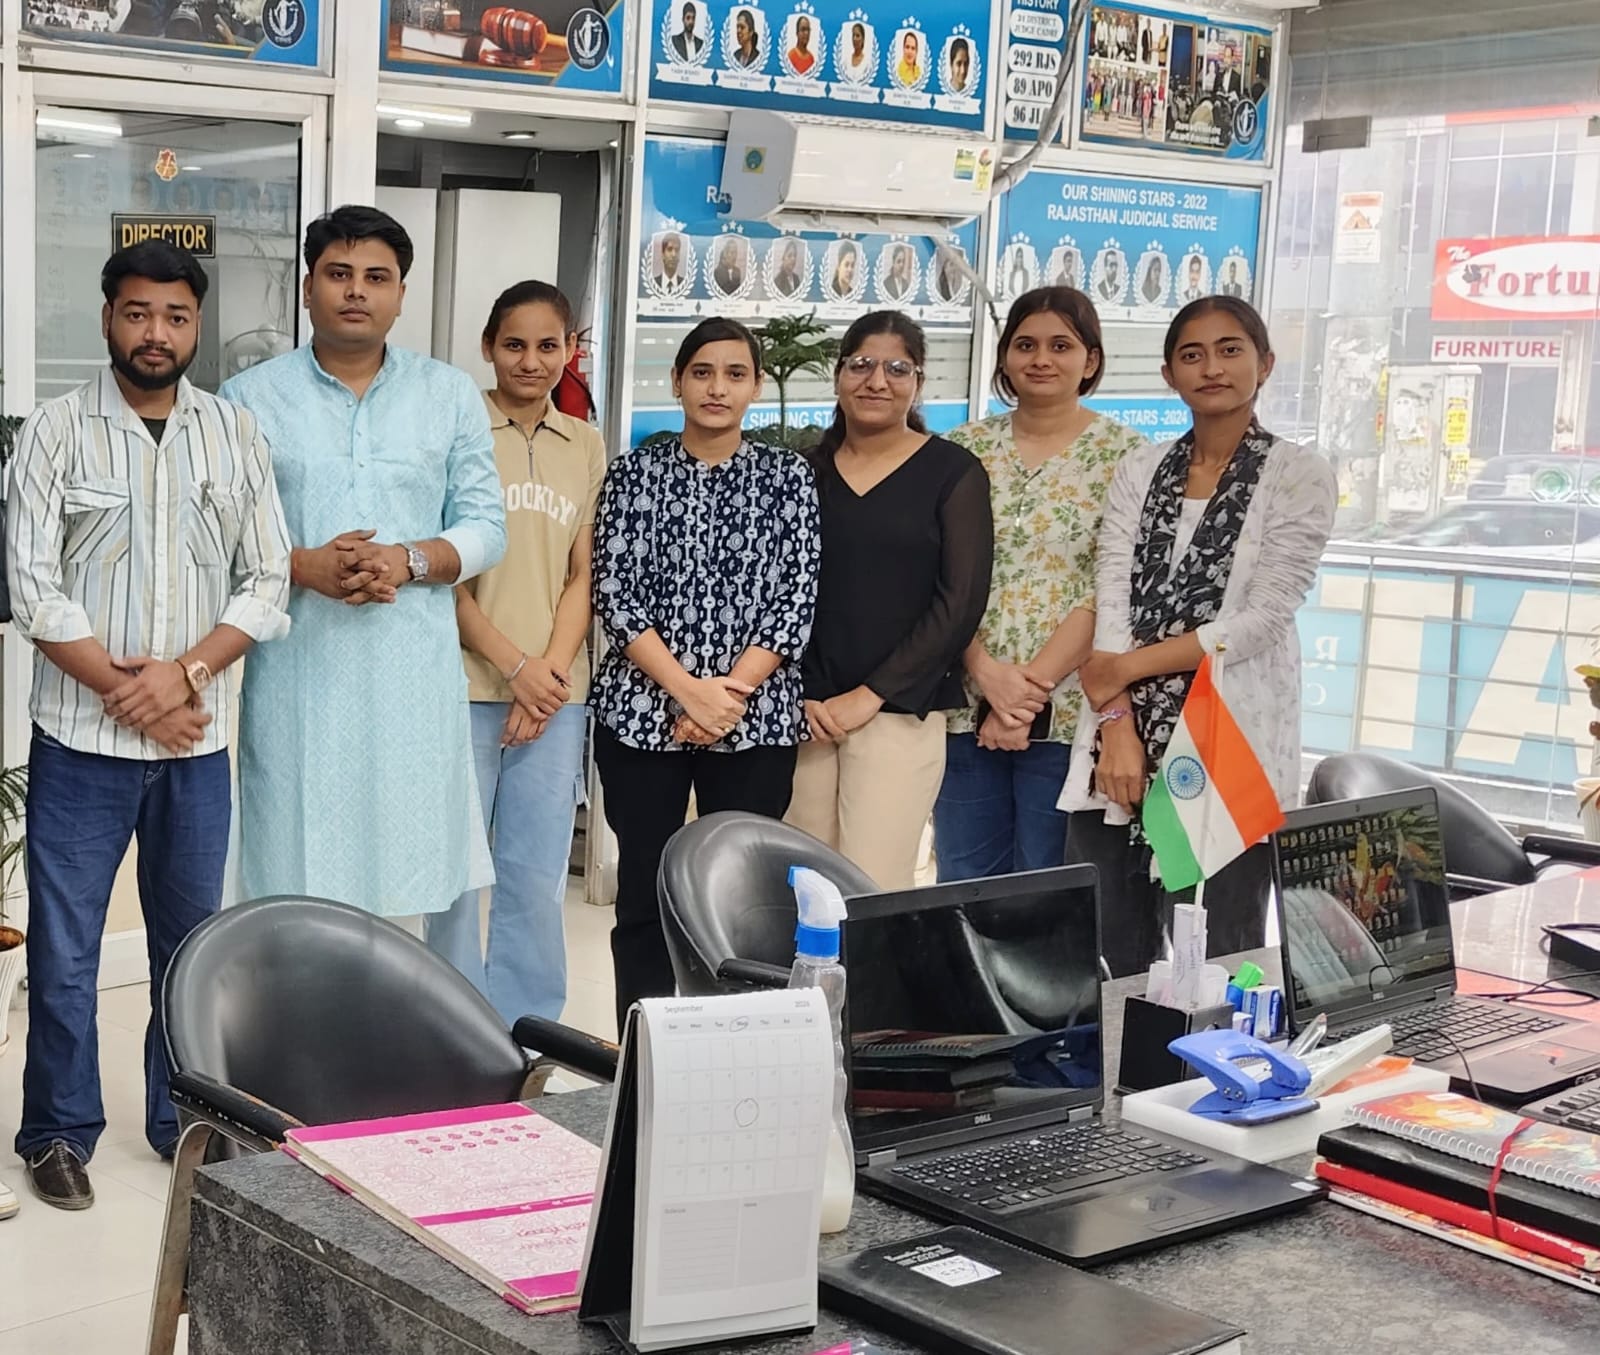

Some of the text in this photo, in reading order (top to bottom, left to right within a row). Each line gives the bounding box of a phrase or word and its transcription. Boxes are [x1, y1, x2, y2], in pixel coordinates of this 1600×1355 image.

[1013, 49, 1057, 71] 292 RJS
[1013, 77, 1052, 97] 89 APO
[1013, 105, 1026, 123] 96
[1062, 183, 1089, 201] OUR
[1090, 186, 1137, 205] SHINING
[1139, 190, 1175, 208] STARS
[1183, 193, 1208, 211] 2022
[1047, 204, 1218, 232] RAJASTHAN JUDICIAL SERVICE
[121, 223, 207, 249] DIRECTOR
[1446, 245, 1471, 263] The
[1466, 263, 1600, 297] Fortu
[1434, 340, 1561, 358] FURNITURE
[1122, 409, 1158, 426] STARS
